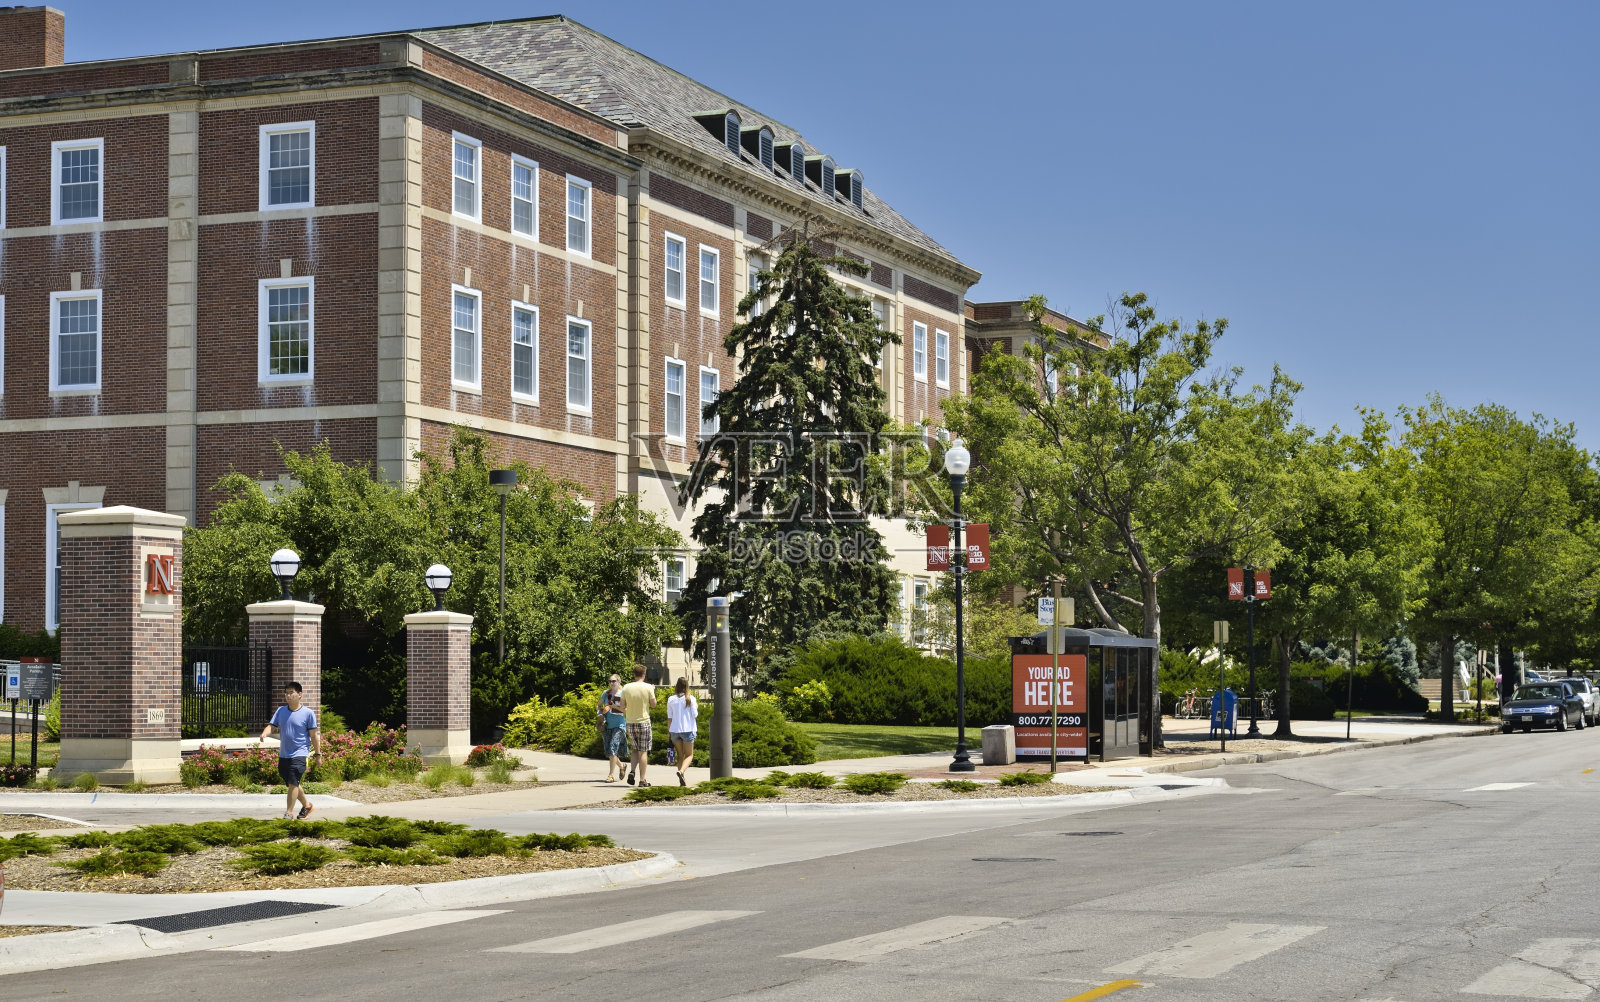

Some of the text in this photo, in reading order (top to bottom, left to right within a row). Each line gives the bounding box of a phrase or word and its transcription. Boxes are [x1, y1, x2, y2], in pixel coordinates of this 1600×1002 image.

[929, 546, 947, 564] N
[145, 554, 174, 595] N
[1230, 582, 1242, 595] N
[710, 635, 718, 688] Emergency
[1028, 667, 1070, 680] YOUR AD
[1025, 681, 1074, 706] HERE
[149, 711, 164, 721] 1869
[1018, 716, 1080, 725] 800.777290
